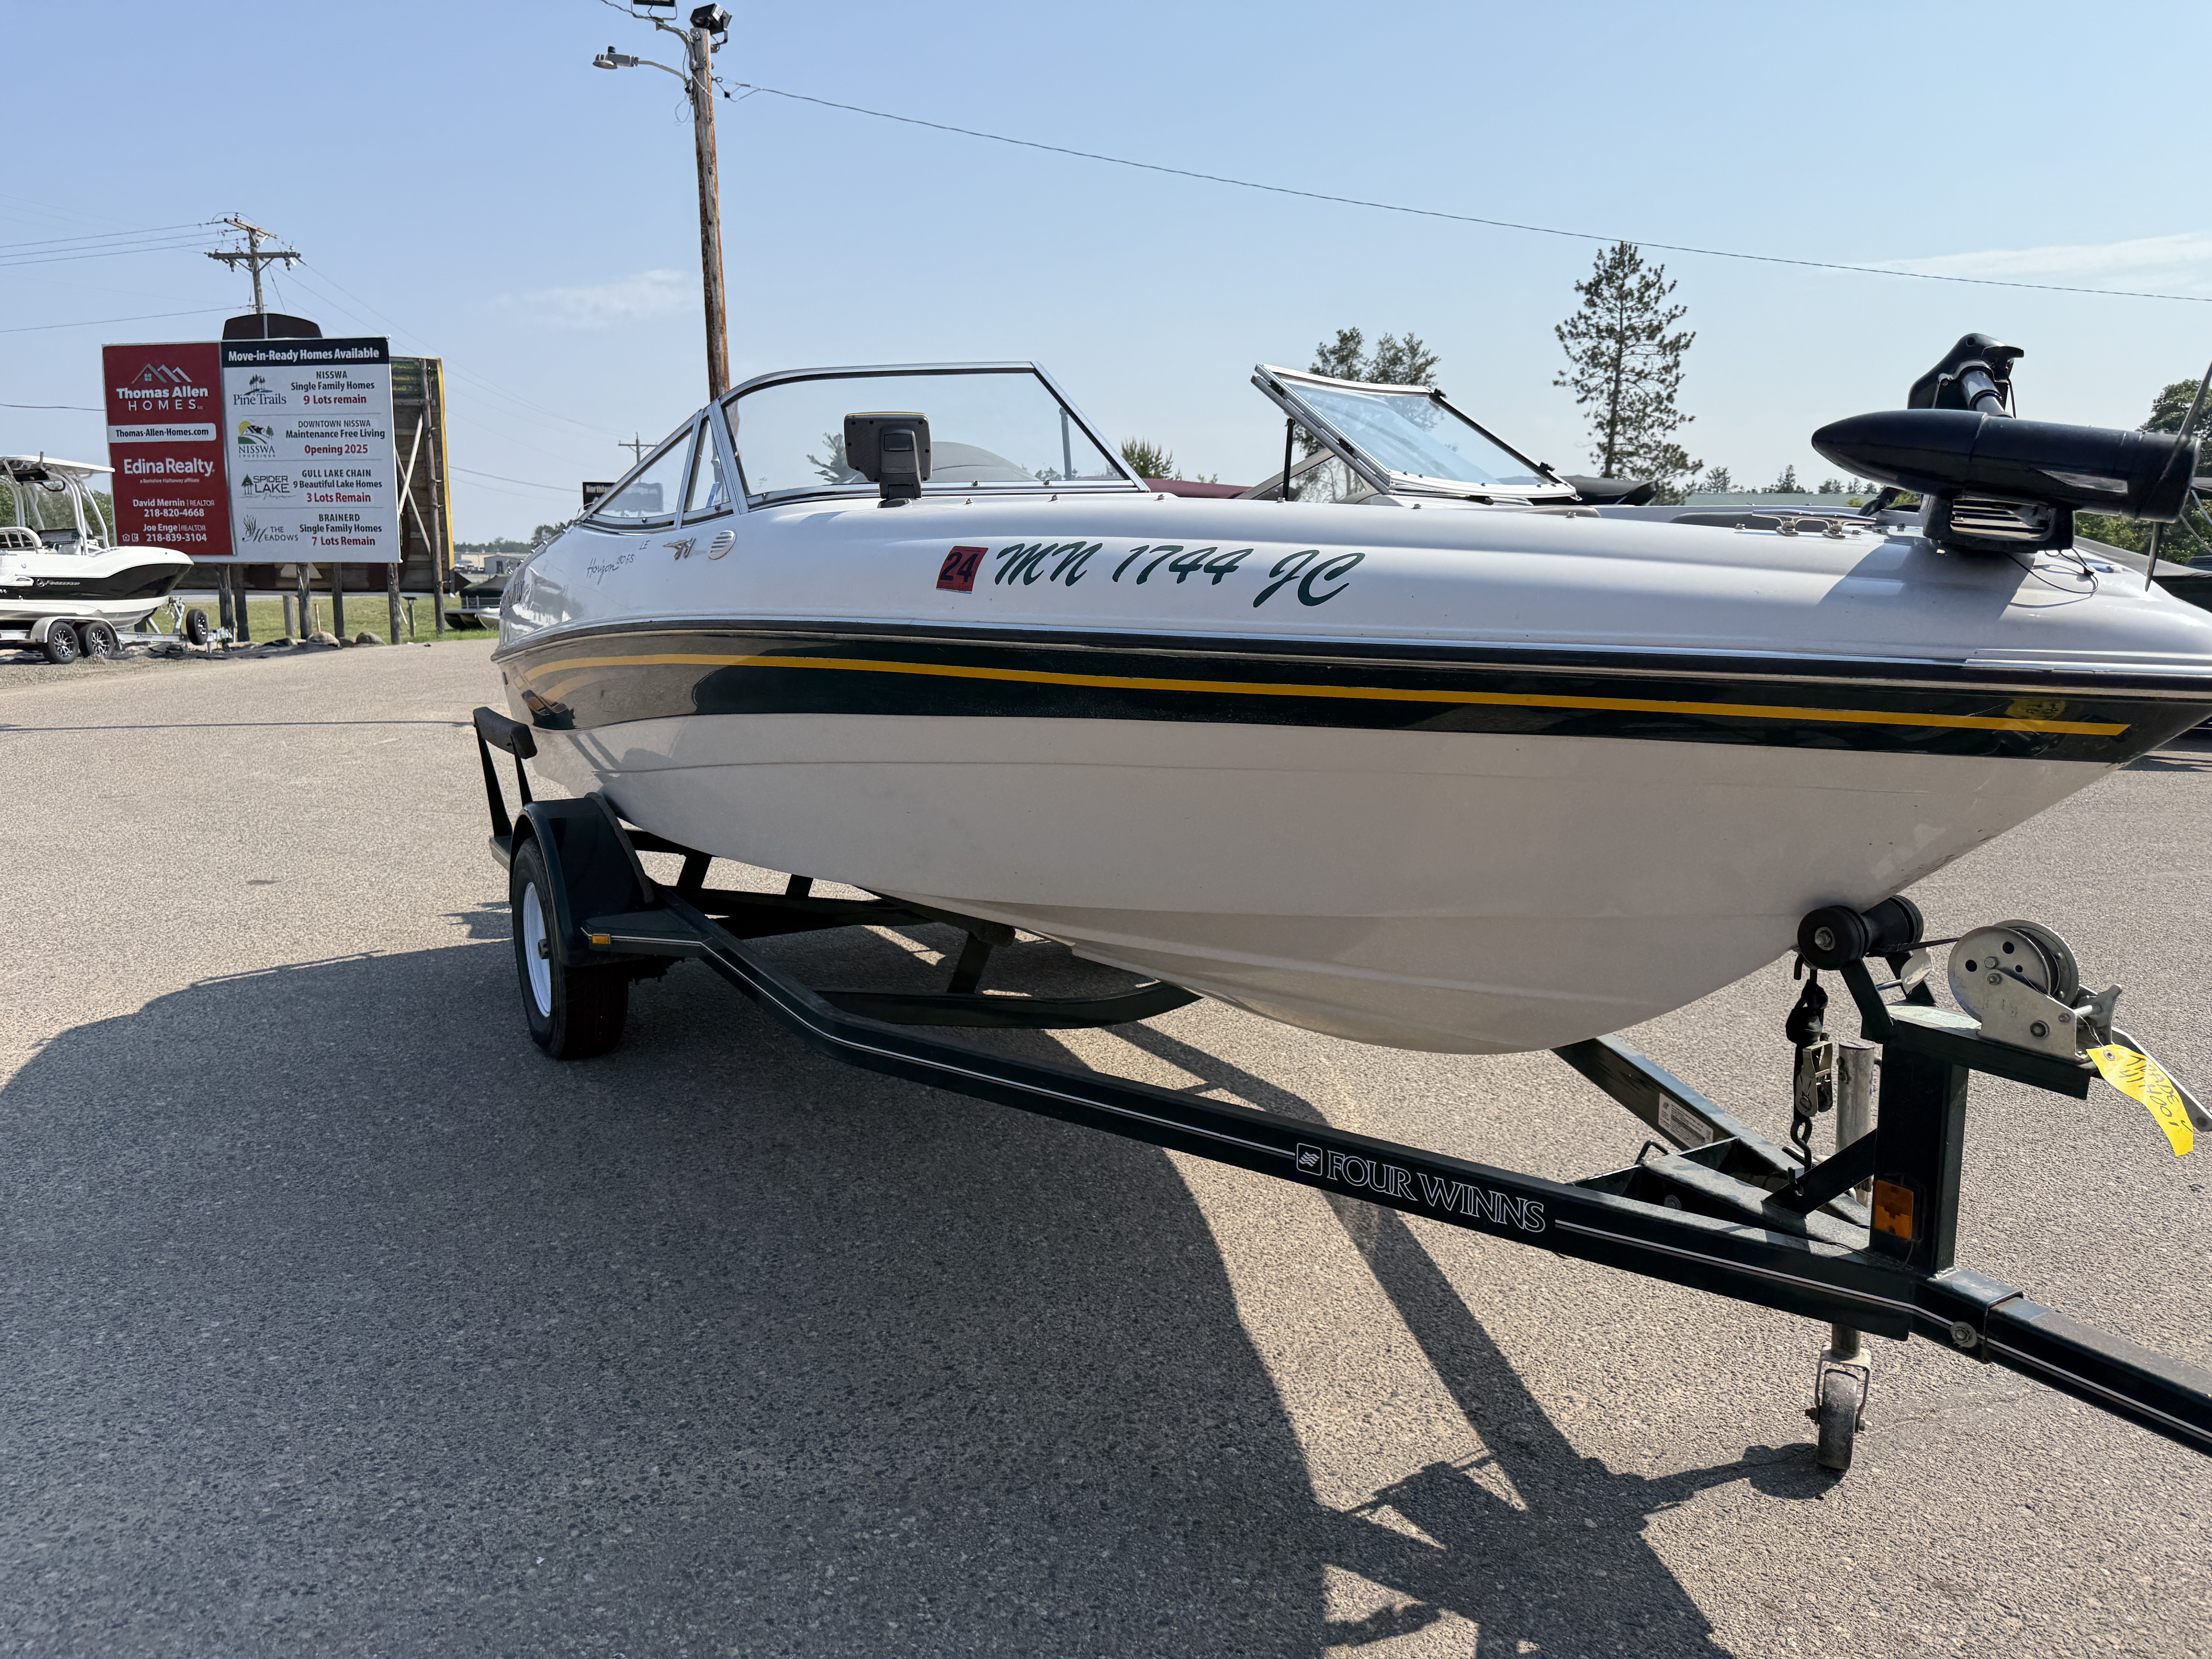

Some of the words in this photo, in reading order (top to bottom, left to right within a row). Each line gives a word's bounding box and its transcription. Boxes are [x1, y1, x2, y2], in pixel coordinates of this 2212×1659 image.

[228, 350, 299, 362] Move-in-Ready
[300, 349, 333, 360] Homes
[334, 347, 380, 359] Available
[316, 371, 347, 379] NISSWA
[291, 381, 316, 392] Single
[318, 381, 345, 391] Family
[347, 381, 375, 389] Homes
[116, 388, 169, 399] Thomas
[172, 386, 208, 398] Allen
[234, 394, 256, 405] Pine
[256, 393, 287, 405] Trails
[303, 395, 310, 405] 9
[313, 394, 332, 404] Lots
[334, 393, 367, 404] remain
[129, 399, 196, 411] HOMES
[115, 428, 209, 437] Thomas-Allen-Homes.com
[286, 430, 338, 438] Maintenance
[340, 429, 358, 438] Free
[360, 429, 385, 439] Living
[239, 445, 275, 453] NISSWA
[304, 445, 343, 455] Opening
[345, 444, 368, 453] 2025
[302, 469, 322, 477] GULL
[324, 469, 344, 477] LAKE
[346, 469, 371, 477] CHAIN
[255, 483, 290, 493] LAKE
[299, 480, 335, 488] Beautiful
[336, 480, 354, 488] Lake
[356, 480, 382, 488] Homes
[307, 492, 312, 502] 3
[314, 492, 333, 502] Lots
[335, 492, 371, 502] Remain
[133, 498, 155, 507] David
[144, 508, 204, 517] 218-820-4668
[319, 514, 360, 522] BRAINERD
[143, 524, 156, 532] Joe
[300, 524, 324, 534] Single
[326, 524, 352, 534] Family
[354, 524, 382, 532] Homes
[146, 533, 207, 542] 218-839-3104
[312, 537, 317, 546] 7
[321, 537, 339, 546] Lots
[341, 536, 376, 546] Remain
[587, 558, 619, 585] Horizon
[639, 540, 651, 550] LE
[940, 552, 979, 582] 24
[995, 541, 1103, 587] MN
[1111, 544, 1254, 585] 1744
[1327, 1150, 1419, 1201] FOUR
[1417, 1172, 1546, 1232] WINNS
